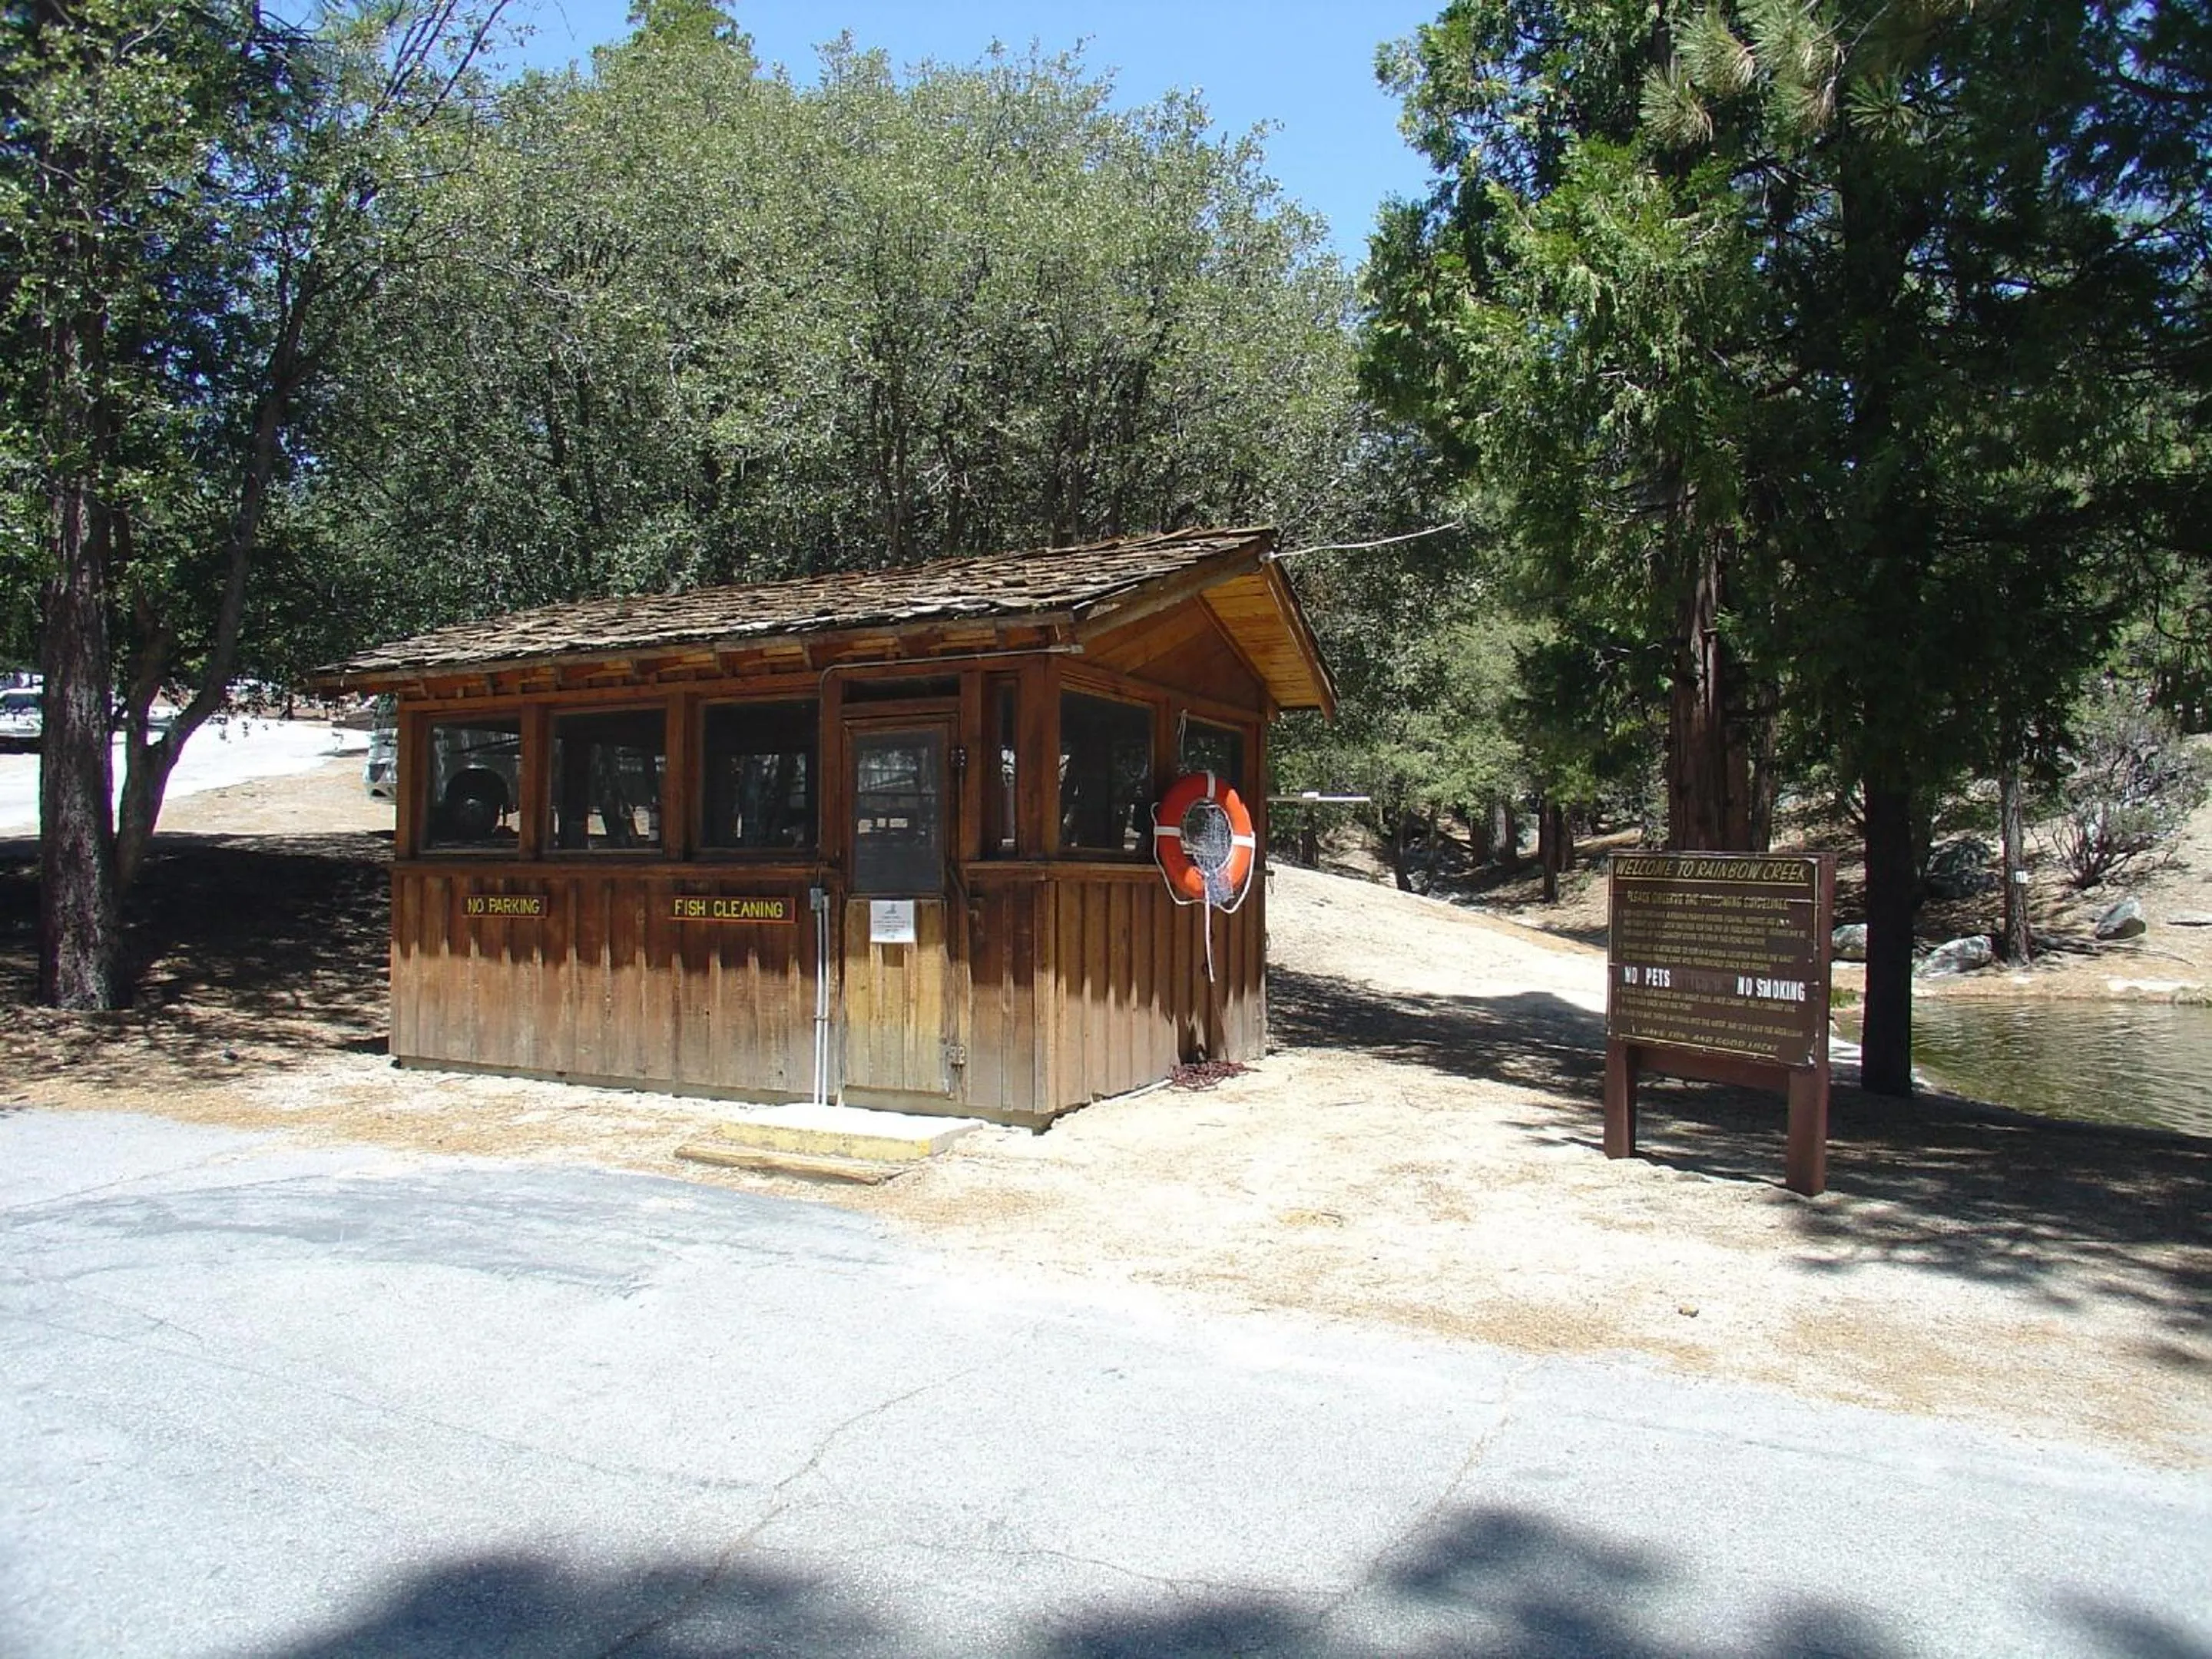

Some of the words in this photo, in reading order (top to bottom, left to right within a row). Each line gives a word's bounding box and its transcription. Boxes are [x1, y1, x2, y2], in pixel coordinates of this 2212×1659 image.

[1615, 859, 1673, 876] WELCOME
[1677, 860, 1694, 878] TO
[1695, 861, 1763, 880] RAINBOW
[1763, 862, 1805, 881] CREEK
[467, 897, 485, 916] NO
[488, 897, 540, 914] PARKING
[674, 899, 706, 916] FISH
[713, 900, 783, 919] CLEANING
[1624, 966, 1638, 985] NO
[1645, 967, 1671, 988] PETS
[1737, 975, 1753, 996] NO
[1756, 978, 1806, 1002] SMOKING
